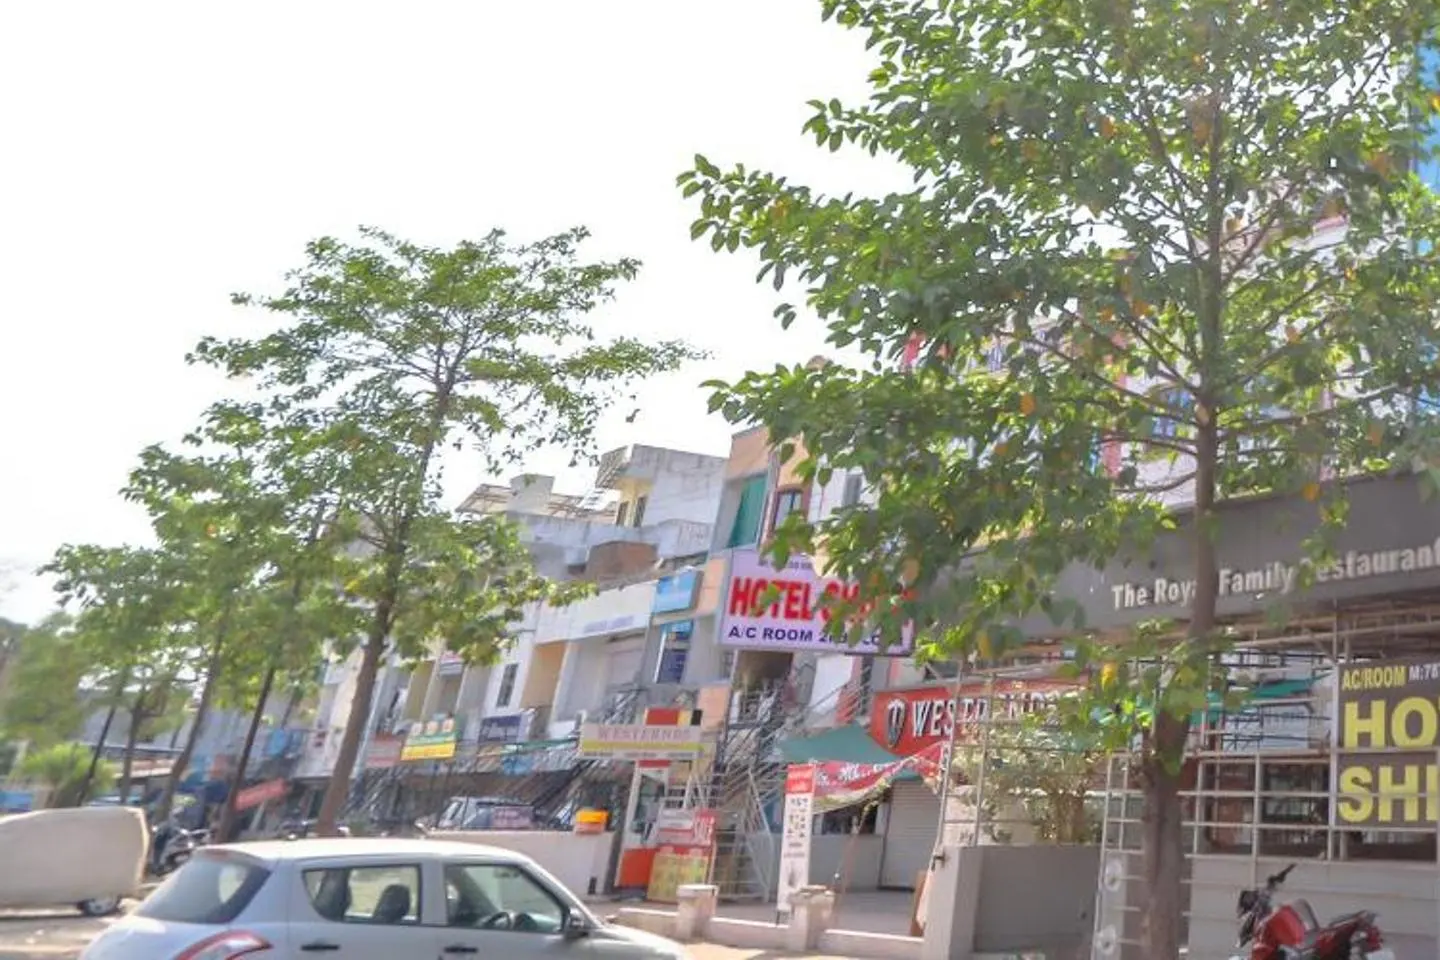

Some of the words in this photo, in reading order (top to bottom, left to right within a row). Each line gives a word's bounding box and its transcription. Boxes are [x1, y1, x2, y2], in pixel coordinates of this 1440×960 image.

[1111, 582, 1148, 610] The
[1154, 578, 1197, 607] Roy
[1218, 564, 1297, 596] Family
[728, 626, 757, 640] A/C
[762, 627, 813, 642] ROOM
